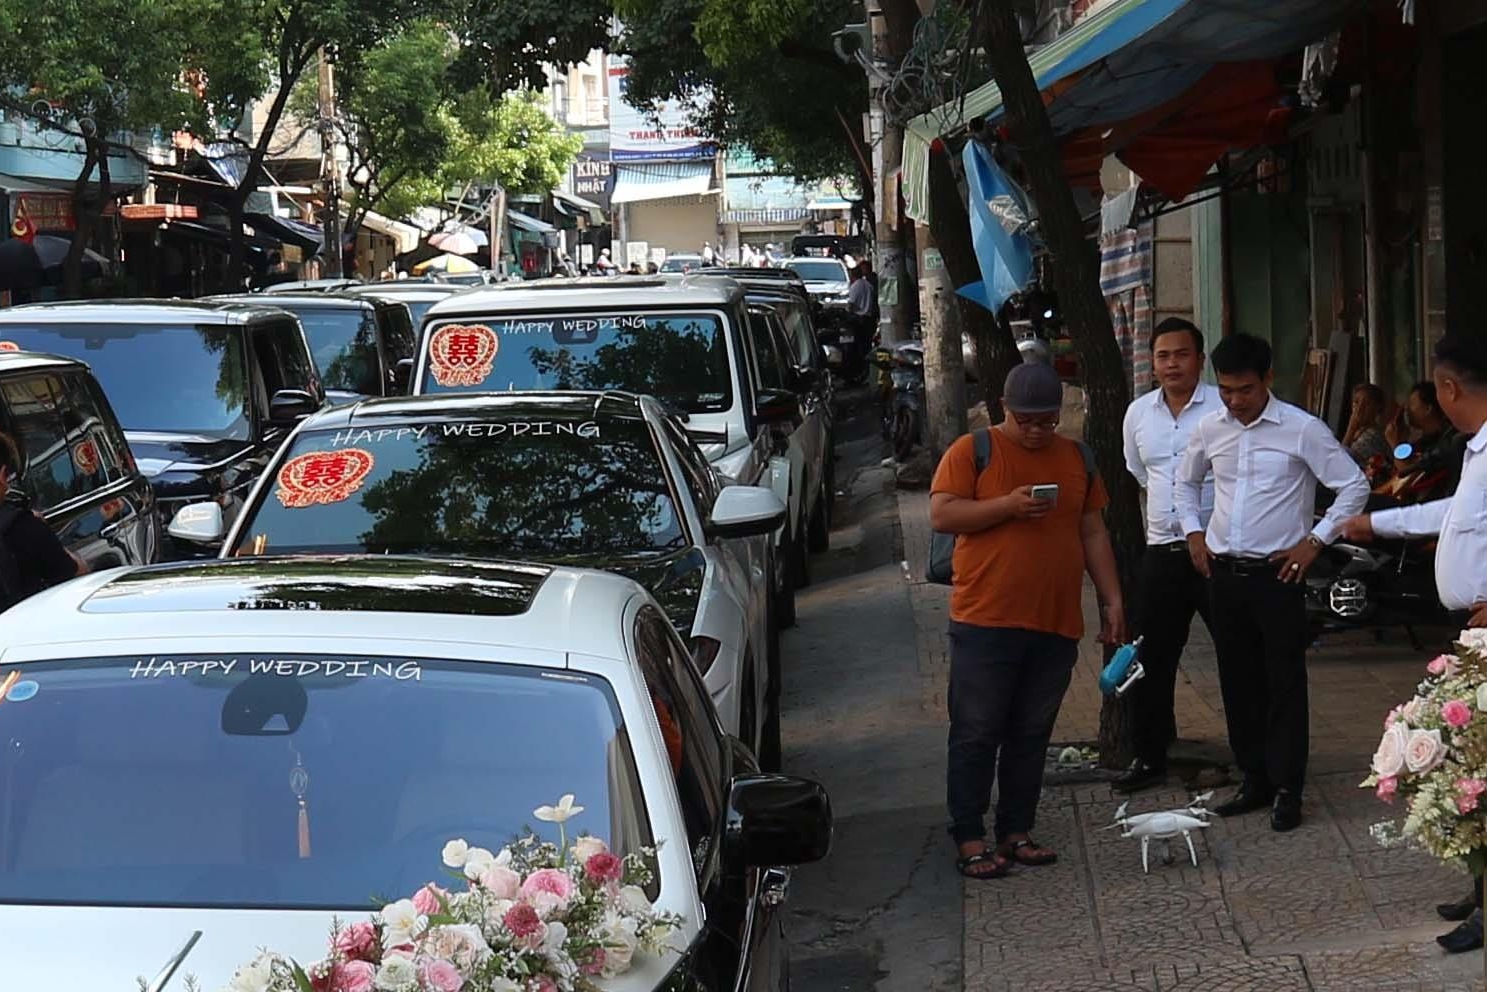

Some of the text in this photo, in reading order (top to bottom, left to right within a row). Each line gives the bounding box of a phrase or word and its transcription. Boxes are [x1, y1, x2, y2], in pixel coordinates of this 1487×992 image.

[502, 315, 647, 334] HAPPY WEDDING
[330, 421, 600, 447] HAPPY WEDDING
[129, 657, 421, 681] HAPPY WEDDING
